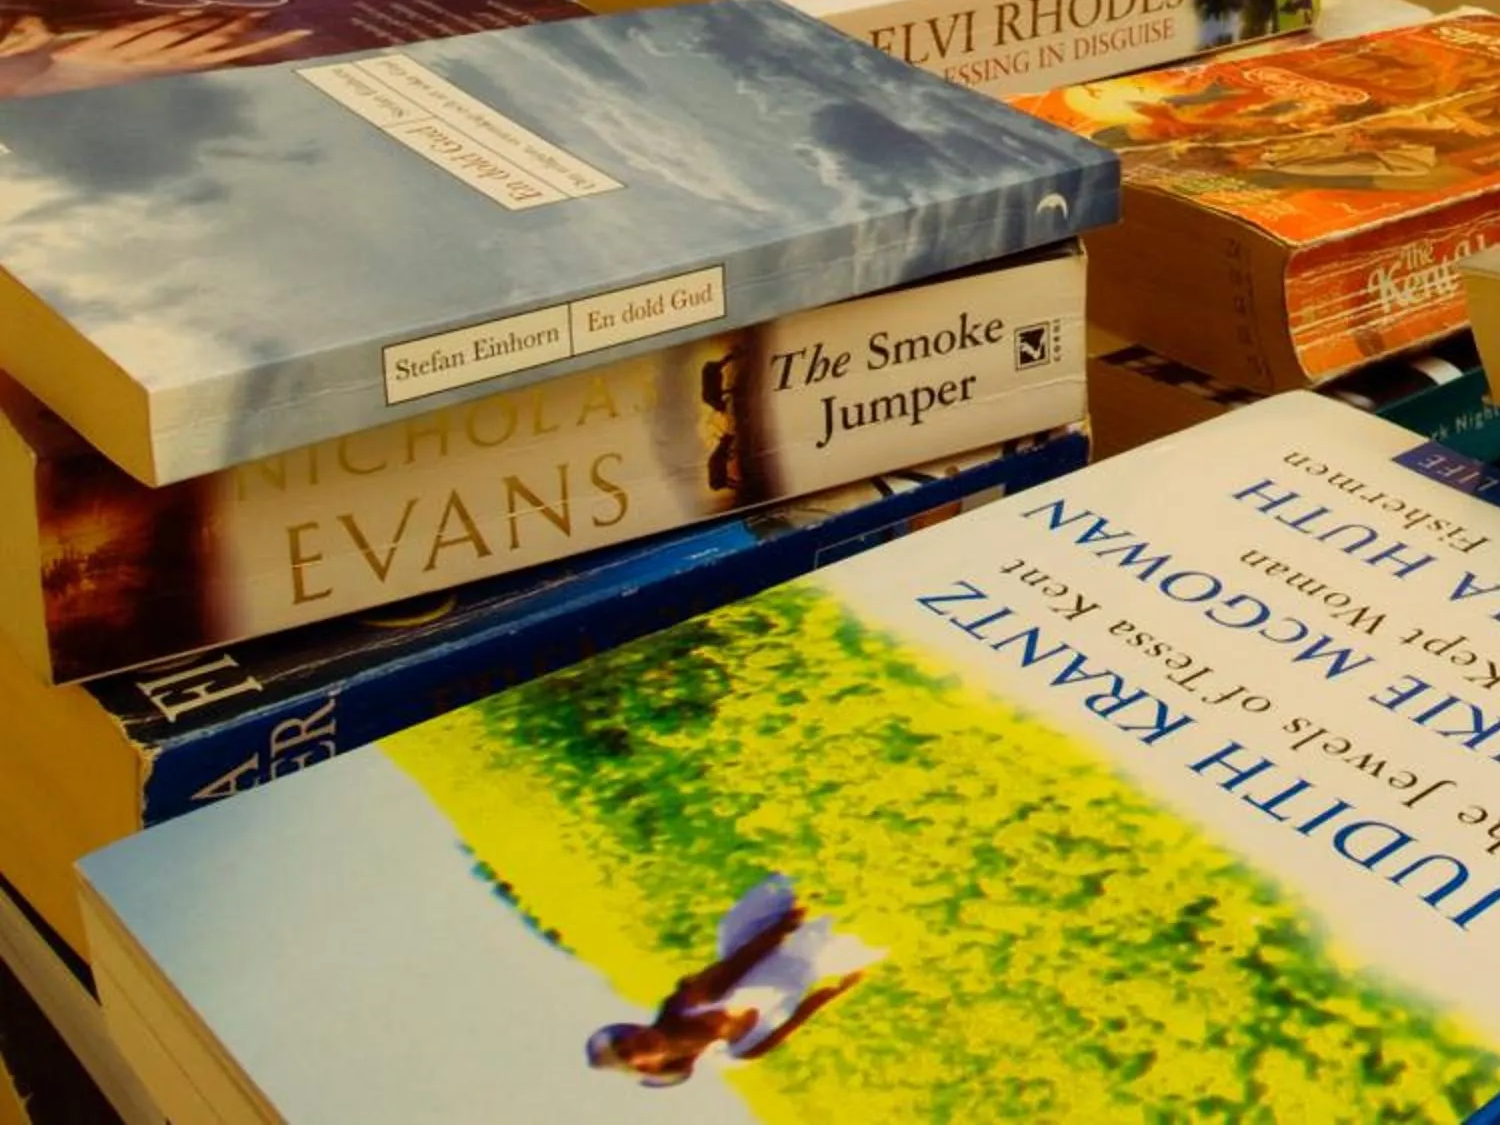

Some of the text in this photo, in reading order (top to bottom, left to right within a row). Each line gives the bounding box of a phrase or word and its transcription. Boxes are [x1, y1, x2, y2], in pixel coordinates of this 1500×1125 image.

[943, 17, 1177, 88] ESSING IN DISGUISE
[587, 282, 715, 334] En dold Gud
[1367, 236, 1462, 315] The Kent
[394, 326, 561, 383] Stefan Einhorn
[770, 312, 1006, 392] The Smoke
[815, 374, 978, 450] Jumper
[1282, 449, 1492, 557] Fishermen
[1415, 452, 1500, 492] LIFE
[286, 452, 631, 606] EVANS
[1231, 477, 1440, 581] HUTH
[1001, 556, 1102, 622] Kent
[1020, 497, 1377, 681] MCGOWAN
[1239, 547, 1388, 635] Woman
[916, 579, 1199, 746] KRANTZ
[1109, 618, 1214, 693] Tessa
[1200, 685, 1273, 716] of
[1281, 715, 1458, 810] Jewels
